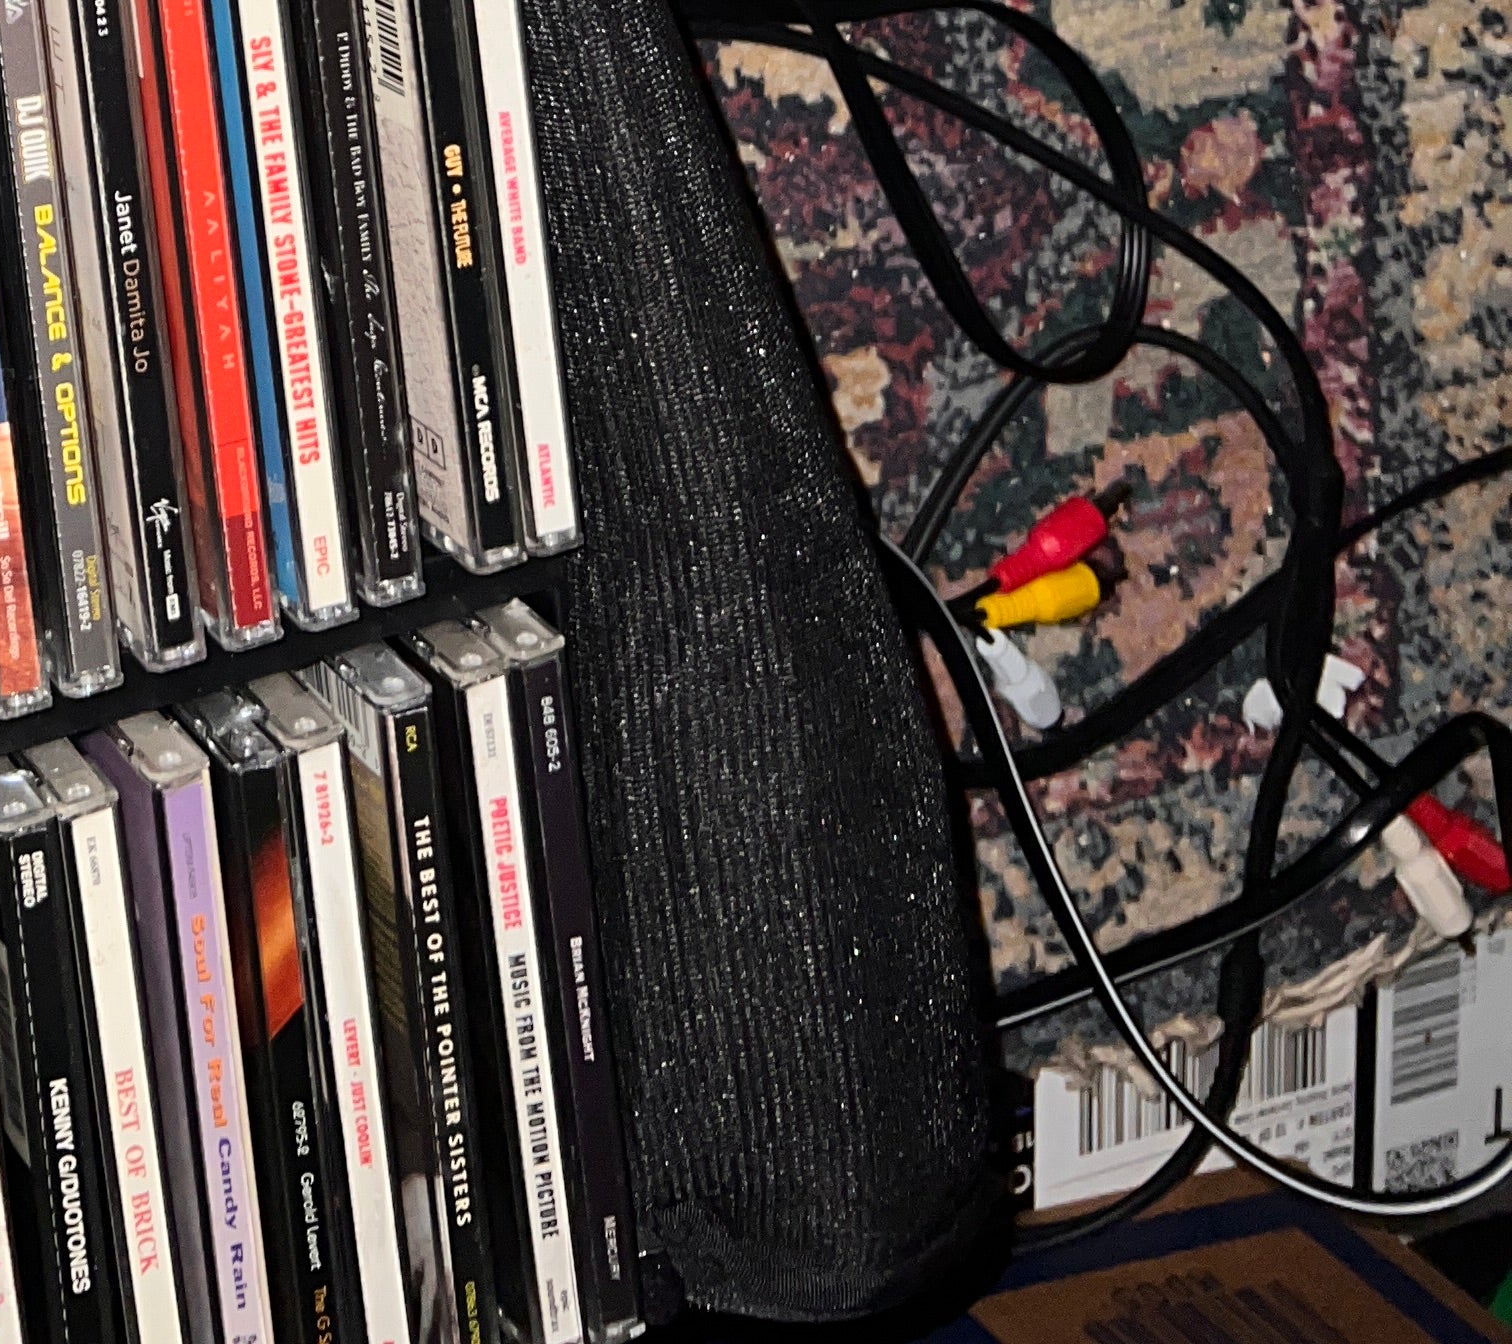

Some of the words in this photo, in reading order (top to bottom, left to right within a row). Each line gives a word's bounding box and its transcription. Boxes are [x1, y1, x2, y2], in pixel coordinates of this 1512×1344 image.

[250, 35, 276, 71] SLY
[14, 95, 46, 127] DJ
[255, 80, 278, 99] &
[259, 105, 284, 146] THE
[499, 110, 518, 174] AVERAGE
[19, 128, 52, 182] QUIK
[444, 143, 464, 176] GUY
[264, 150, 294, 224] FAMILY
[449, 199, 469, 224] THE
[506, 175, 523, 222] WHITE
[114, 189, 139, 255] Janet
[452, 224, 473, 269] FUTURE
[511, 224, 528, 265] BAND
[34, 203, 68, 341] BALANCE
[121, 259, 147, 342] Damita
[52, 351, 74, 371] &
[133, 346, 151, 373] Jo
[55, 381, 87, 505] OPTIONS
[294, 418, 320, 466] HITS
[405, 724, 419, 752] RCA
[414, 814, 434, 860] THE
[489, 795, 515, 856] POETIC
[419, 867, 441, 923] BEST
[497, 860, 523, 930] JUSTICE
[191, 913, 213, 983] Soul
[427, 932, 445, 963] OF
[570, 935, 586, 983] BRIAN
[431, 970, 451, 1016] THE
[509, 953, 532, 1009] MUSIC
[200, 992, 216, 1047] For
[516, 1013, 538, 1060] FROM
[115, 1067, 142, 1130] BEST
[207, 1057, 229, 1128] Real
[436, 1022, 462, 1126] POINTER
[522, 1065, 543, 1096] THE
[49, 1077, 76, 1150] KENNY
[527, 1101, 551, 1165] MOTION
[125, 1144, 148, 1178] OF
[218, 1137, 239, 1229] Candy
[448, 1132, 473, 1226] SISTERS
[58, 1153, 92, 1294] G/DUOTONES
[535, 1170, 560, 1239] PICTURE
[131, 1190, 160, 1275] BRICK
[230, 1241, 248, 1309] Rain
